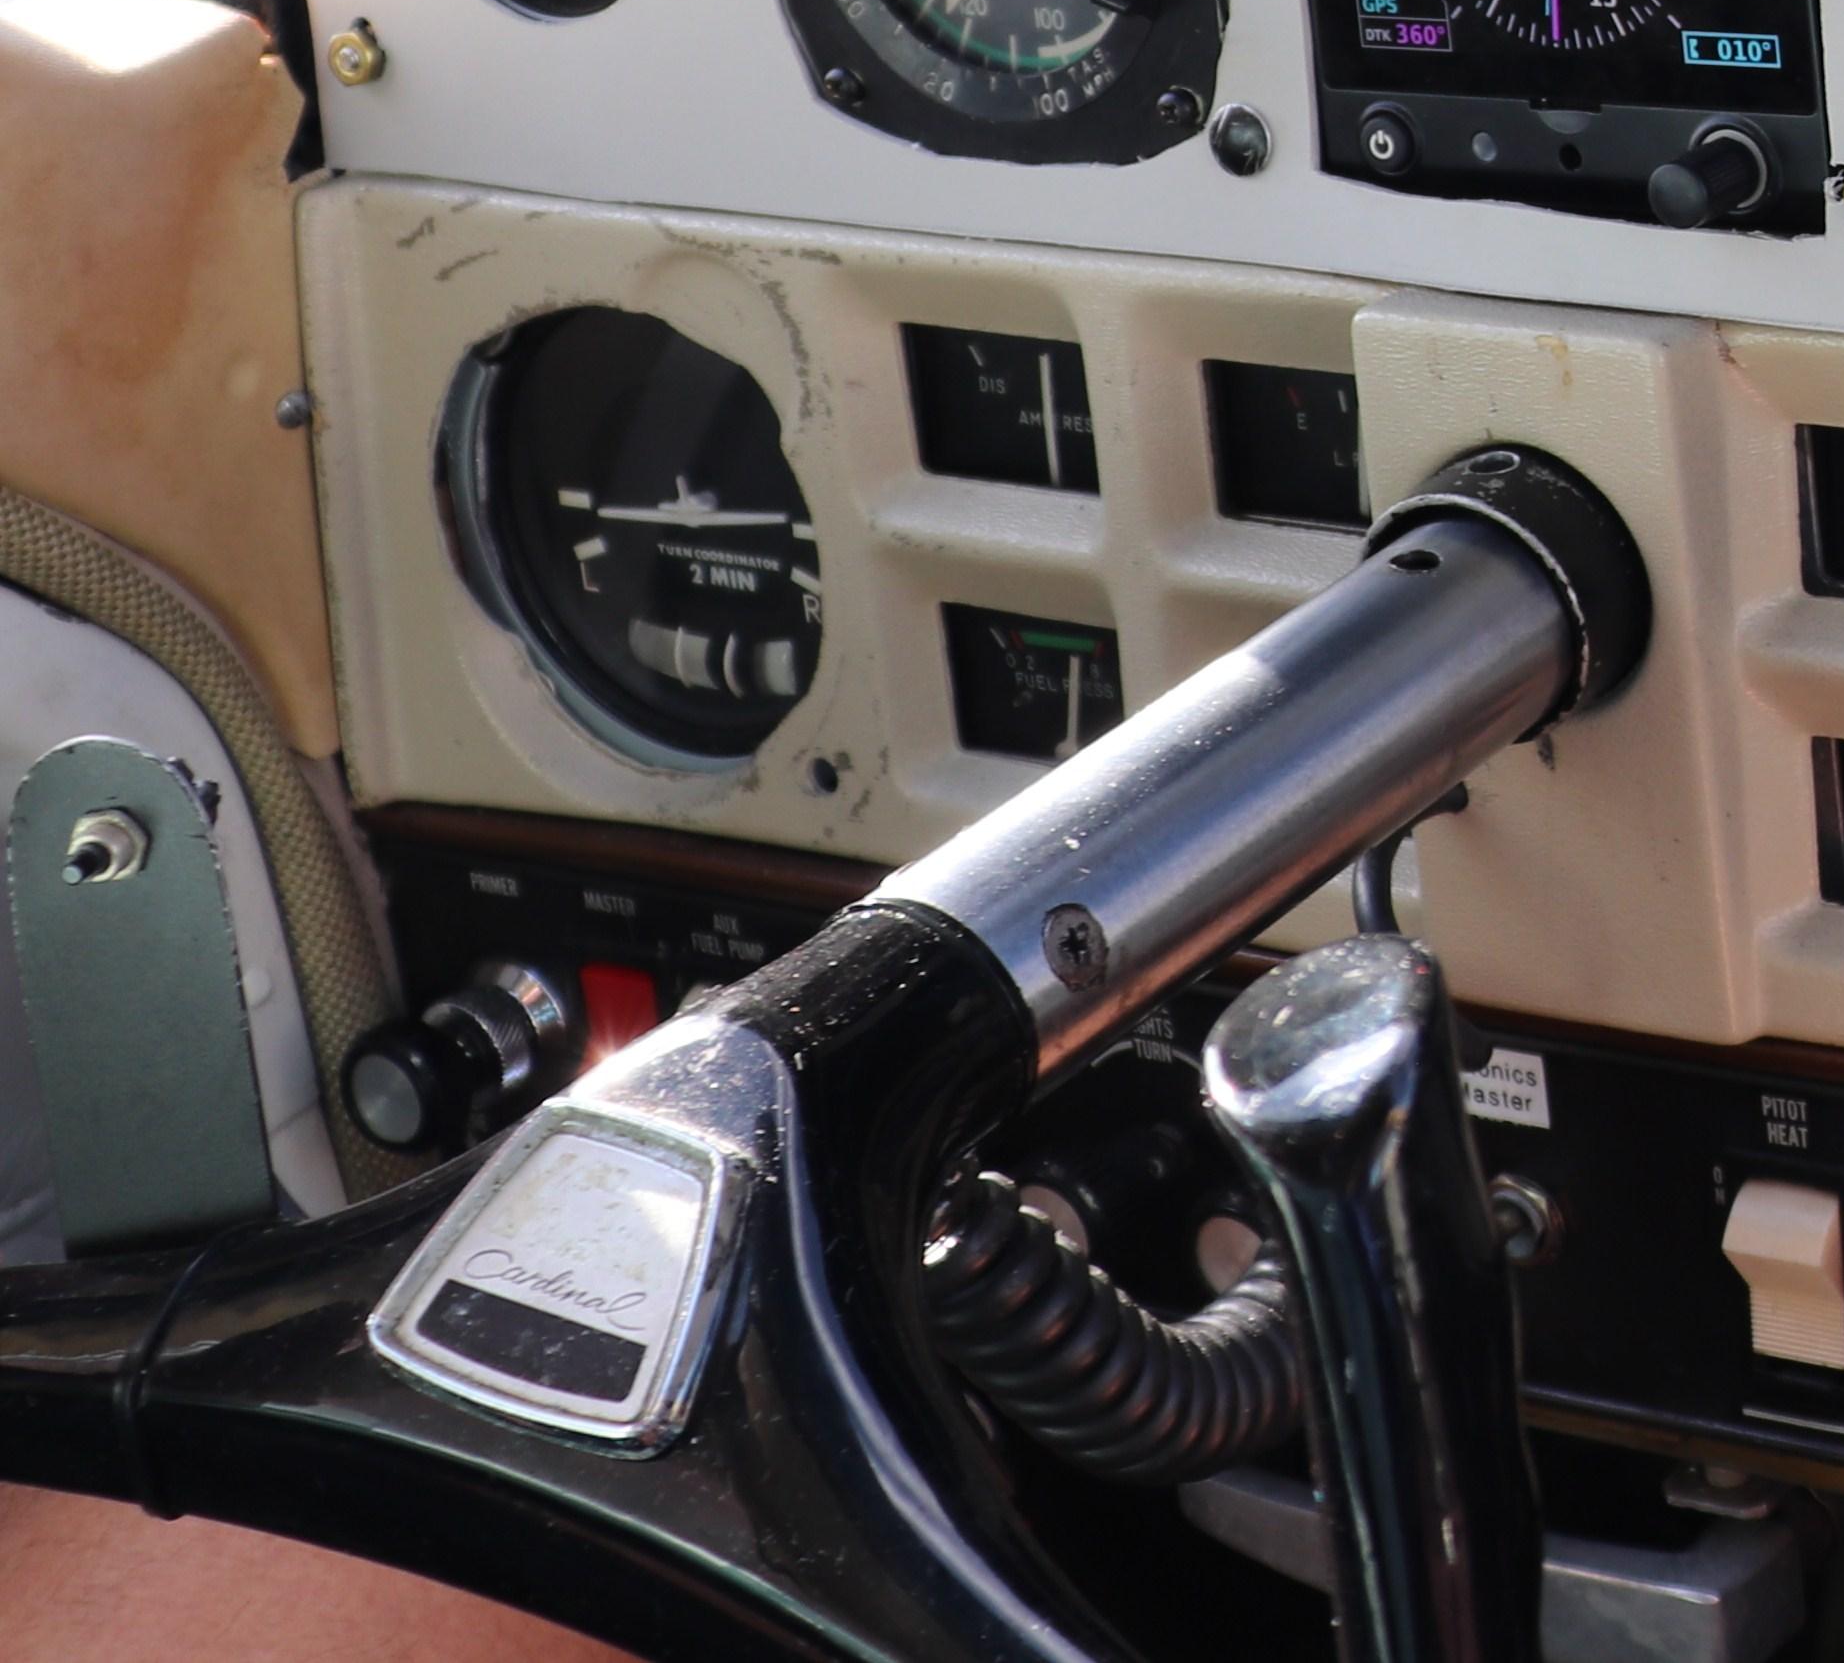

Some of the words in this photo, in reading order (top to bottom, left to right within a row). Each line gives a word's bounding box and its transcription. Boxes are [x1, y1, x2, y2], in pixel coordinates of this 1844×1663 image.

[690, 564, 704, 583] 2
[710, 566, 755, 591] MIN
[1762, 1095, 1807, 1121] PITOT
[1767, 1122, 1808, 1149] HEAT
[462, 1248, 648, 1334] Cardinal
